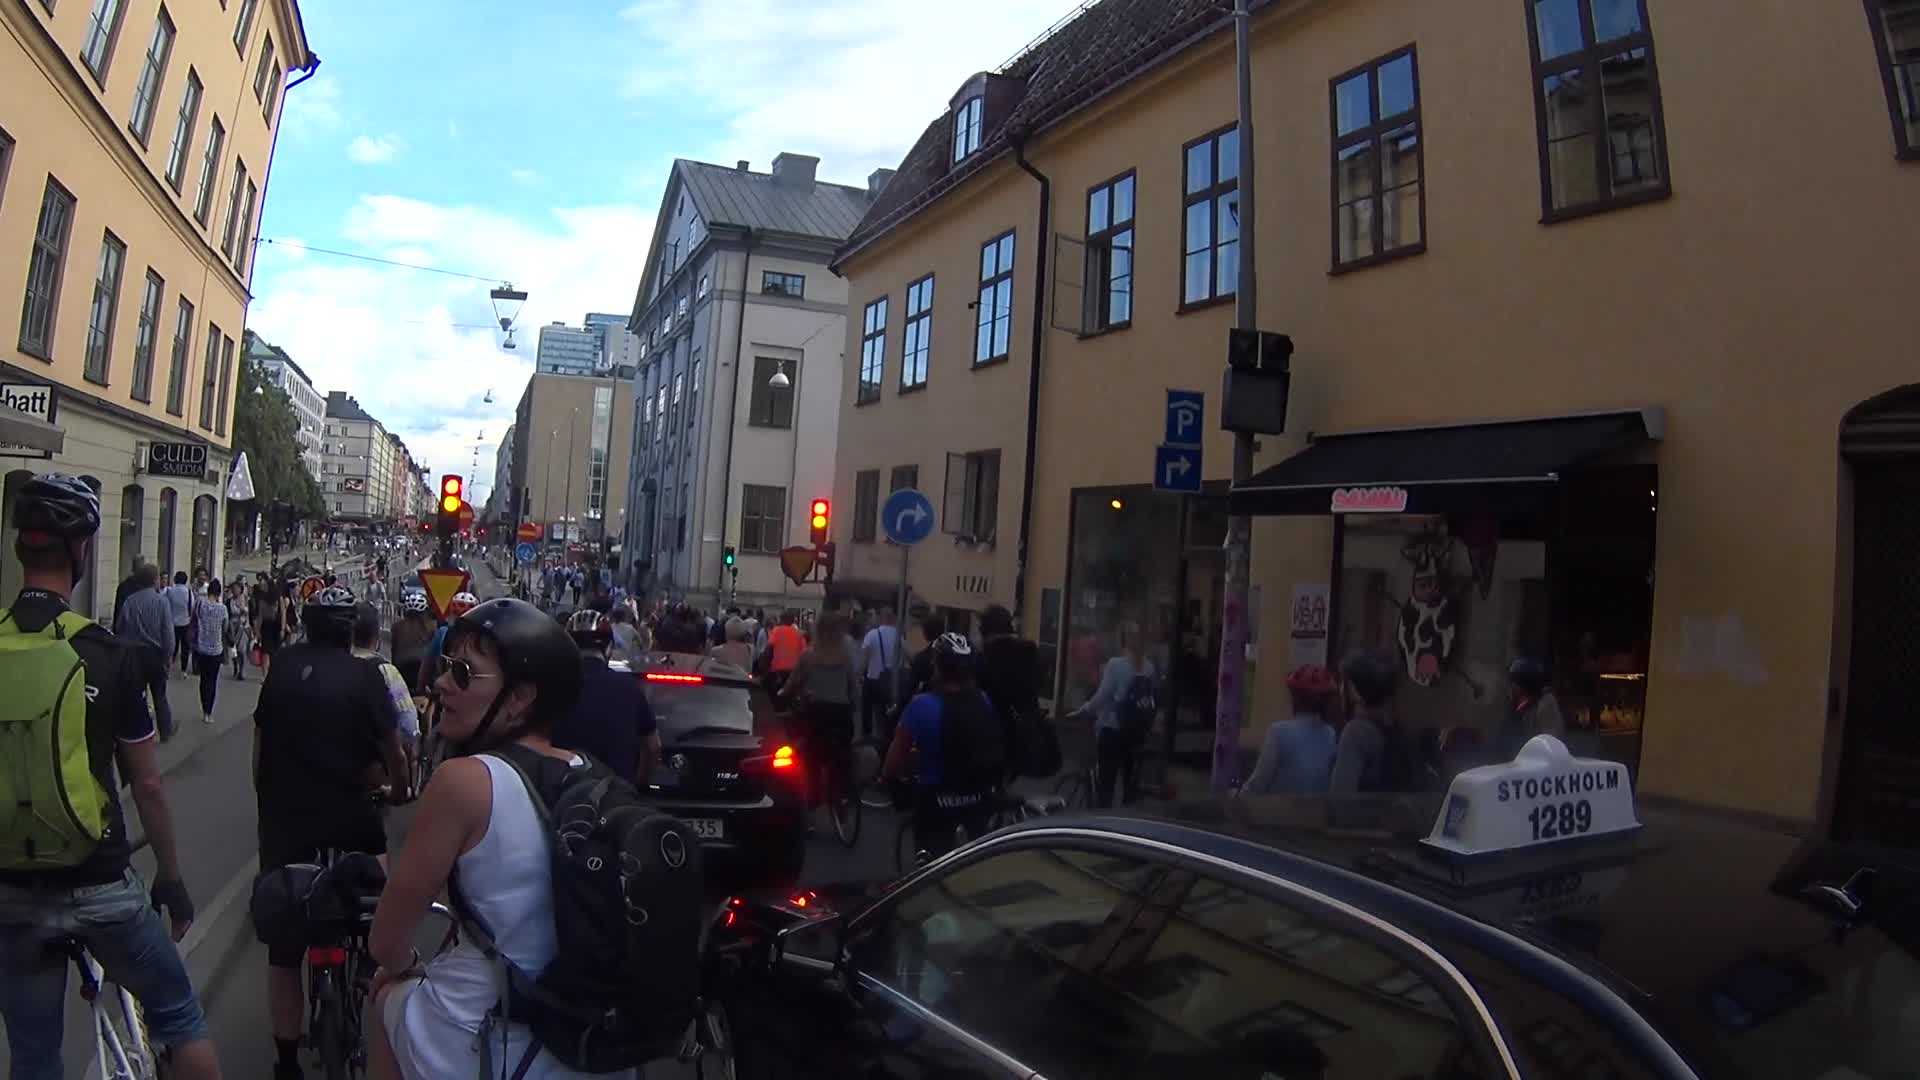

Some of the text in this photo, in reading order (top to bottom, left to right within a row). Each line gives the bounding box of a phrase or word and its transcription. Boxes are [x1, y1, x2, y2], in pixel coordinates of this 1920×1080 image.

[1178, 409, 1193, 435] P
[152, 443, 205, 464] GULD
[1498, 769, 1618, 802] STOCKHOLM
[1528, 800, 1592, 841] 1289
